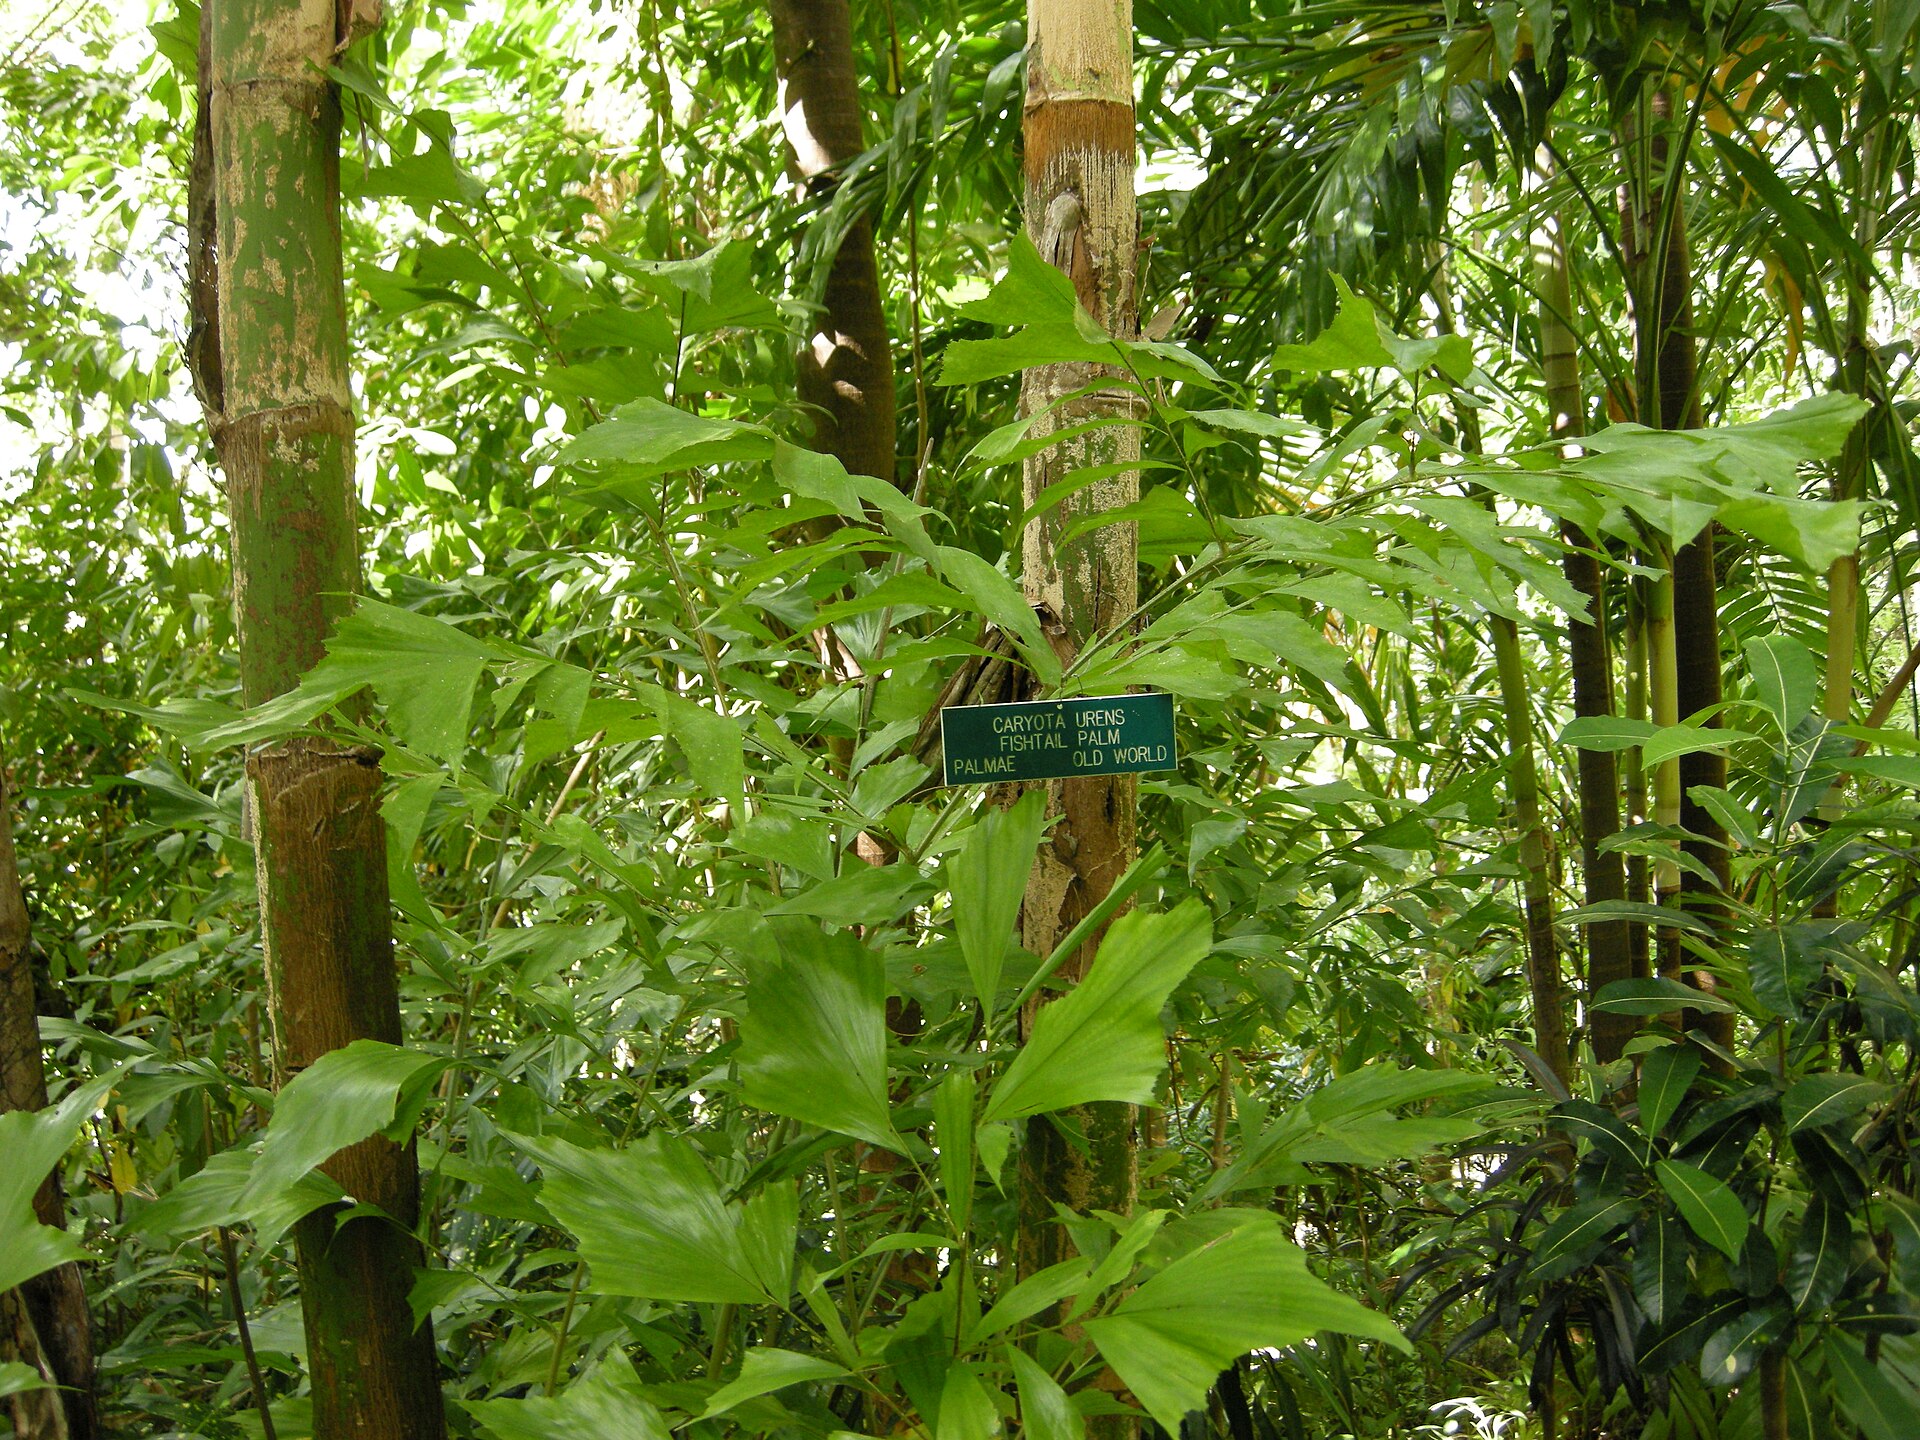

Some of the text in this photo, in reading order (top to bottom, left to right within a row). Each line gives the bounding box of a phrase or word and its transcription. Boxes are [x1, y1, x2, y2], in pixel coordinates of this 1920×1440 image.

[993, 709, 1126, 734] CARYOTA URENS
[1000, 728, 1121, 752] FISHTAIL PALM
[954, 745, 1167, 775] PALMAE OLD WORLD
